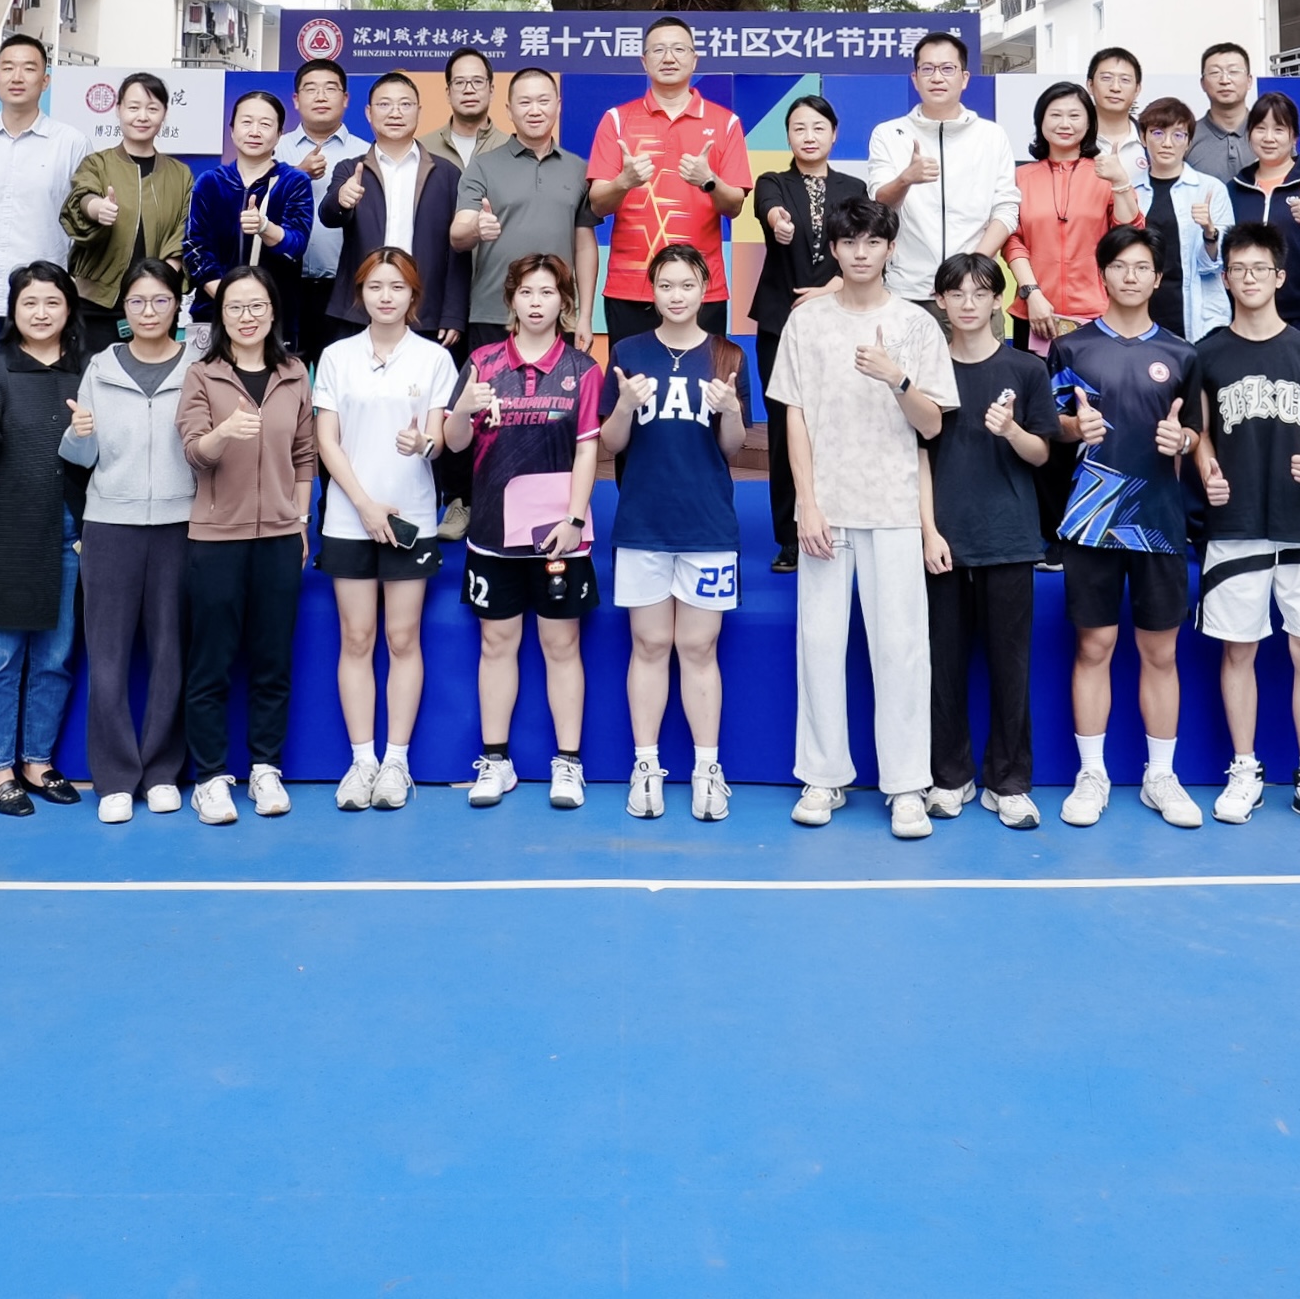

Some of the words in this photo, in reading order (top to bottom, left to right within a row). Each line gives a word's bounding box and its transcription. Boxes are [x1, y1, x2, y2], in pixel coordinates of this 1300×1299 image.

[519, 25, 962, 59] 第十六届生社区文化节开幕
[352, 49, 396, 58] SHENZHEN
[500, 396, 574, 410] BADMINTON
[499, 411, 548, 426] CENTER
[695, 564, 736, 599] 23
